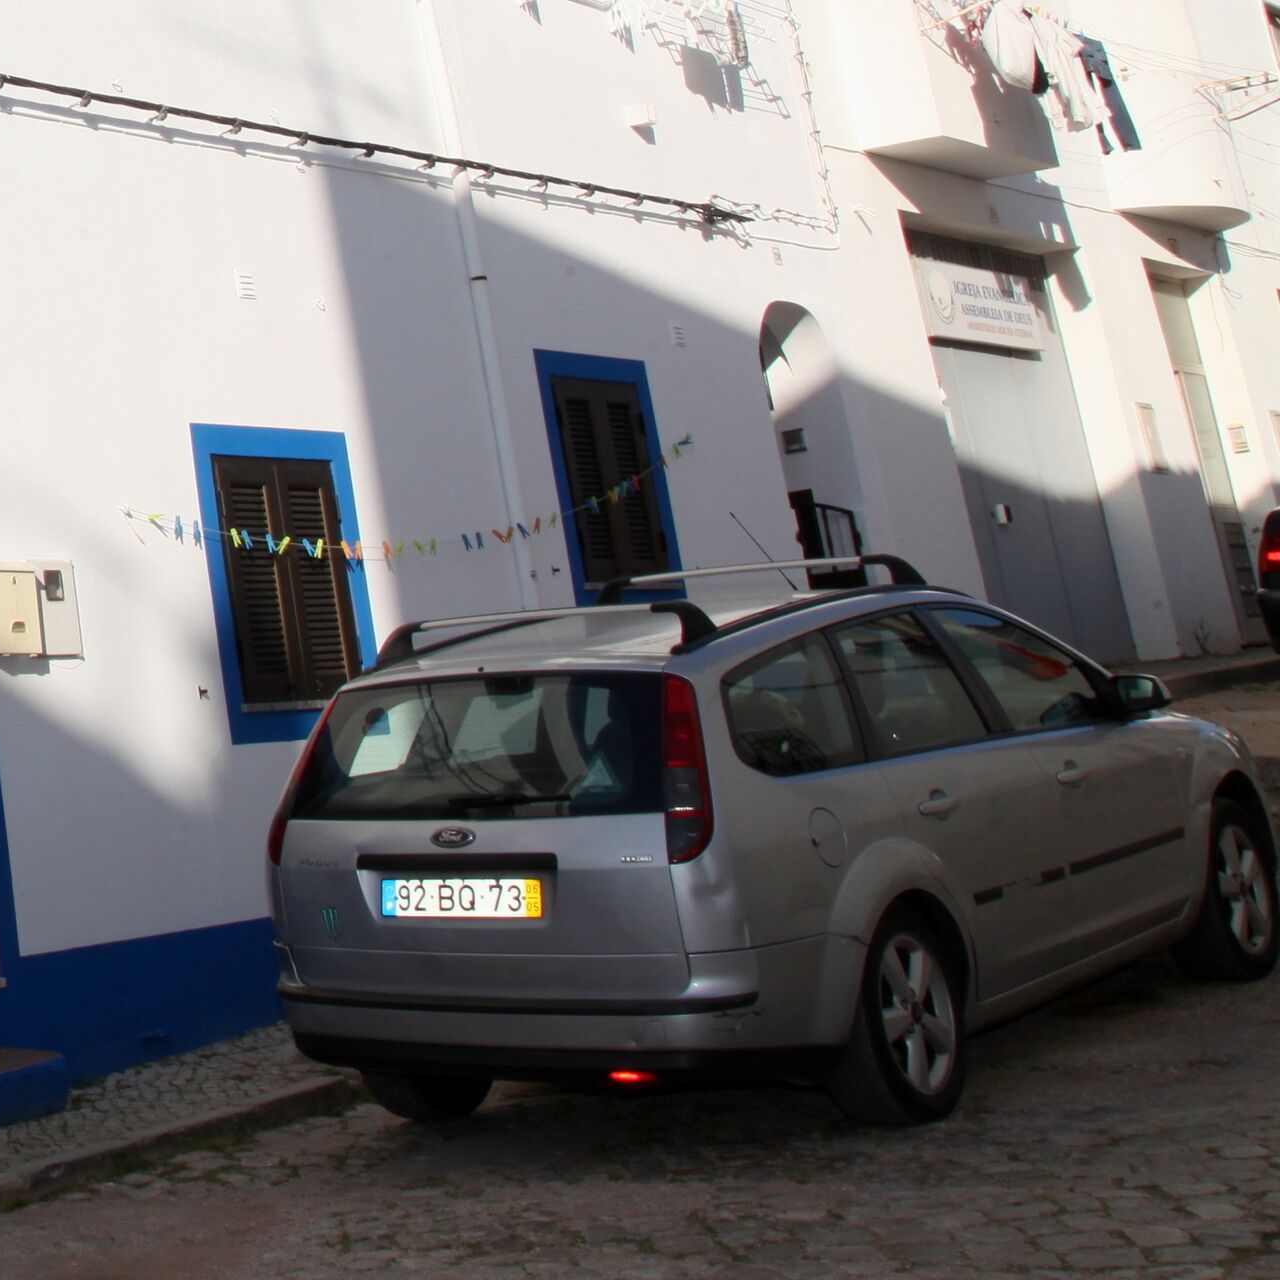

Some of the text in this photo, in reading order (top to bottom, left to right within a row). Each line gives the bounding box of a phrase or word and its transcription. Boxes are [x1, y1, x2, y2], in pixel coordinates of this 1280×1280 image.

[953, 280, 982, 300] IGREJA
[960, 303, 1033, 325] ASSEMBLEIA DE DEUS
[526, 883, 539, 894] 06
[526, 901, 539, 913] 05
